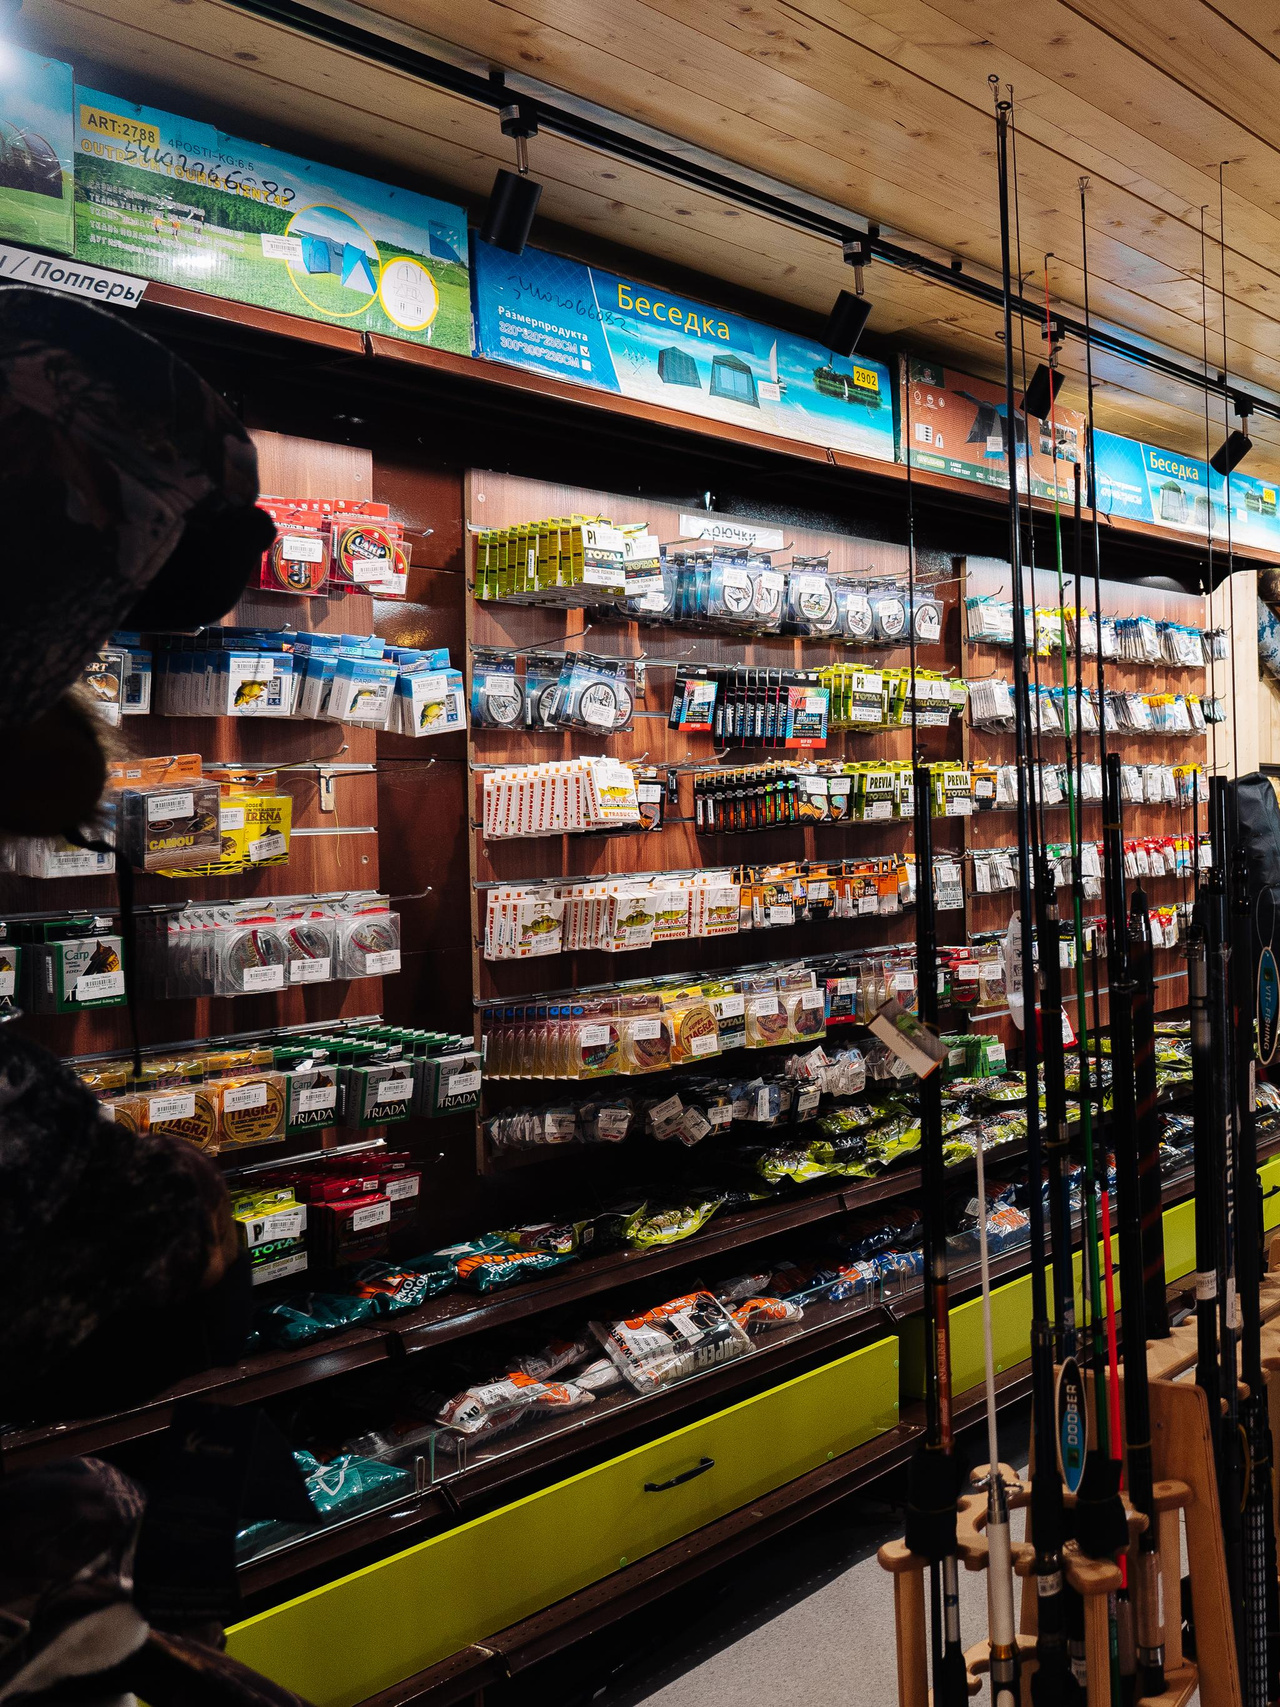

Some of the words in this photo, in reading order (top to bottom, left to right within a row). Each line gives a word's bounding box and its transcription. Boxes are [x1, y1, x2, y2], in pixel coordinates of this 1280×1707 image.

[87, 113, 156, 144] ART:2788
[31, 260, 143, 303] Попперы
[617, 283, 731, 341] Беседка
[855, 369, 877, 387] 2902
[1149, 451, 1200, 481] Беседка
[585, 549, 622, 562] TOTAL
[626, 557, 660, 571] TOTAL
[869, 776, 892, 789] PREVIA
[947, 775, 969, 786] PREVIA
[587, 777, 599, 818] TRABUCCO
[867, 792, 893, 800] TOTAL
[946, 789, 971, 797] TOTAL
[246, 812, 281, 821] IRENA
[150, 836, 194, 850] CAMOU
[777, 892, 793, 903] EAGLE
[865, 886, 879, 896] EAGLE
[659, 931, 686, 939] TRABUCCO
[711, 926, 737, 934] TRABUCCO
[64, 950, 90, 962] Carp
[688, 1017, 705, 1032] SUPER
[1263, 985, 1272, 1050] VIT-FISHING
[684, 1019, 714, 1043] TIAGRA
[440, 1066, 459, 1076] Carp
[292, 1080, 312, 1090] Carp
[368, 1075, 387, 1085] Carp
[438, 1092, 477, 1108] TRIADA
[229, 1101, 279, 1121] TIAGRA
[290, 1109, 334, 1126] TRIADA
[364, 1103, 406, 1120] TRIADA
[160, 1118, 209, 1138] TIAGRA
[1066, 1385, 1078, 1445] DODGER
